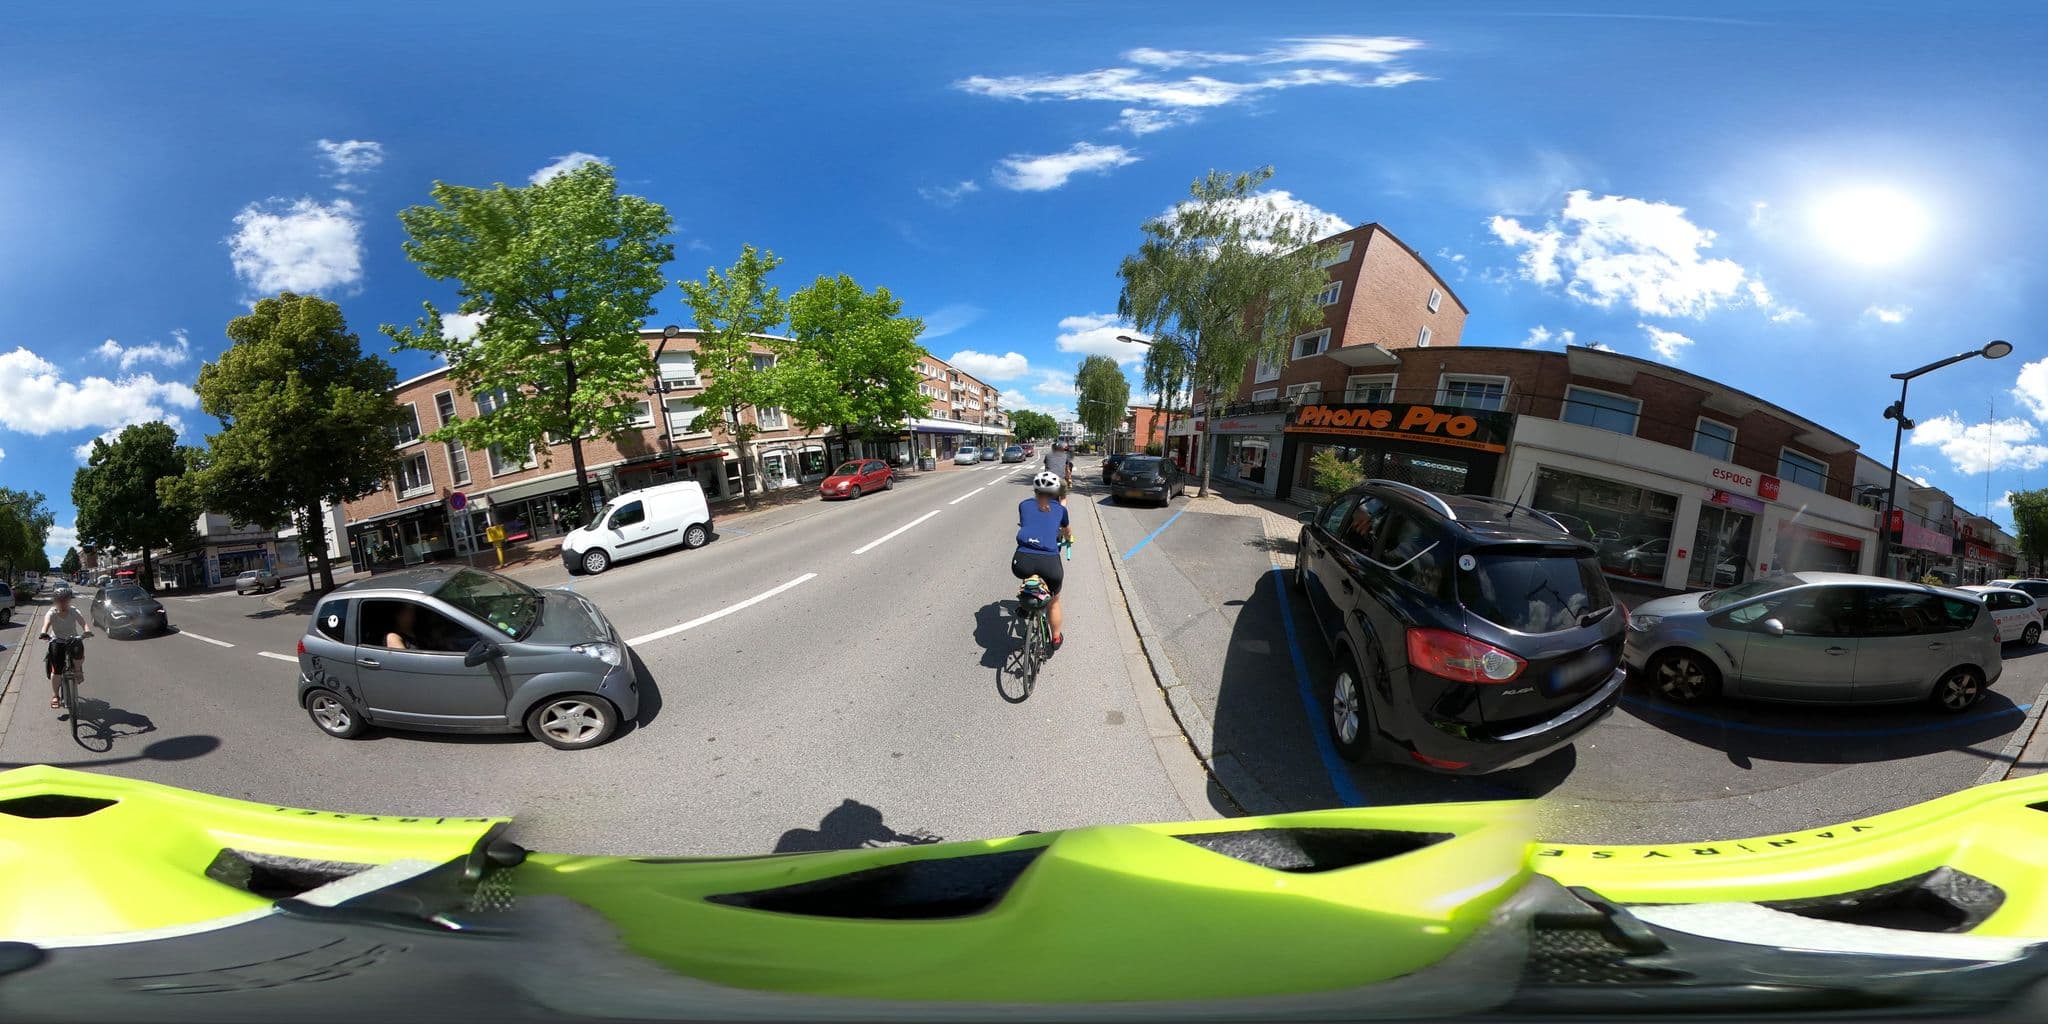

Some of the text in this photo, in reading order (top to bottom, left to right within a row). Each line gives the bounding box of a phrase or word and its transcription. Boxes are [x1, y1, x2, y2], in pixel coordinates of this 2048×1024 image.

[1297, 405, 1478, 437] Phone Pro
[1712, 467, 1779, 493] espace SFR
